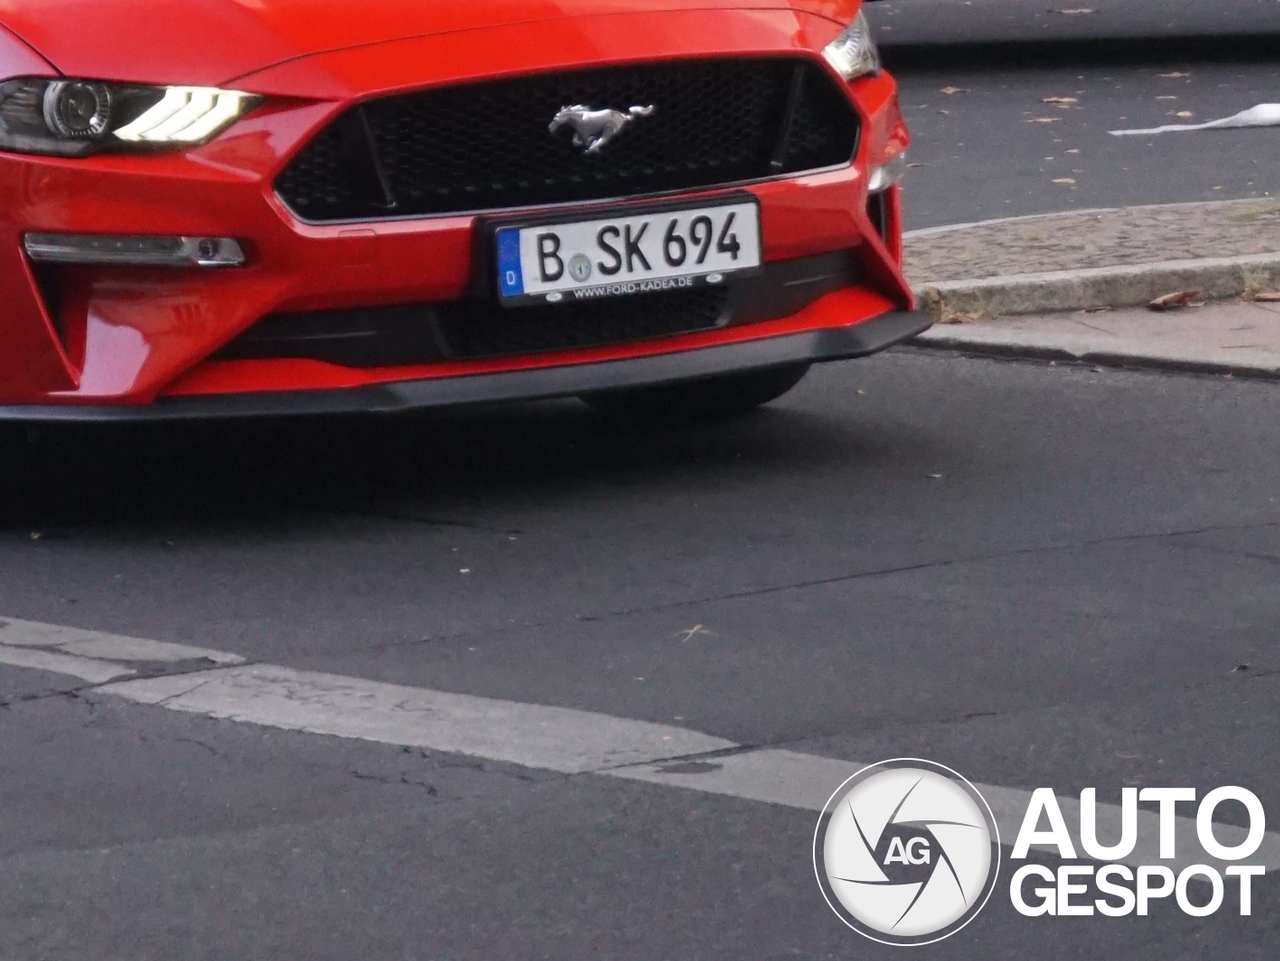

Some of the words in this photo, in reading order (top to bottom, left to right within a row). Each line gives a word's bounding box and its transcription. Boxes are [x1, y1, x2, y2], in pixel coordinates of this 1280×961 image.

[536, 232, 564, 283] B
[596, 221, 652, 276] SK
[662, 211, 741, 267] 694
[506, 270, 517, 286] D
[573, 276, 693, 299] WWW.FORD-KADEA.DE
